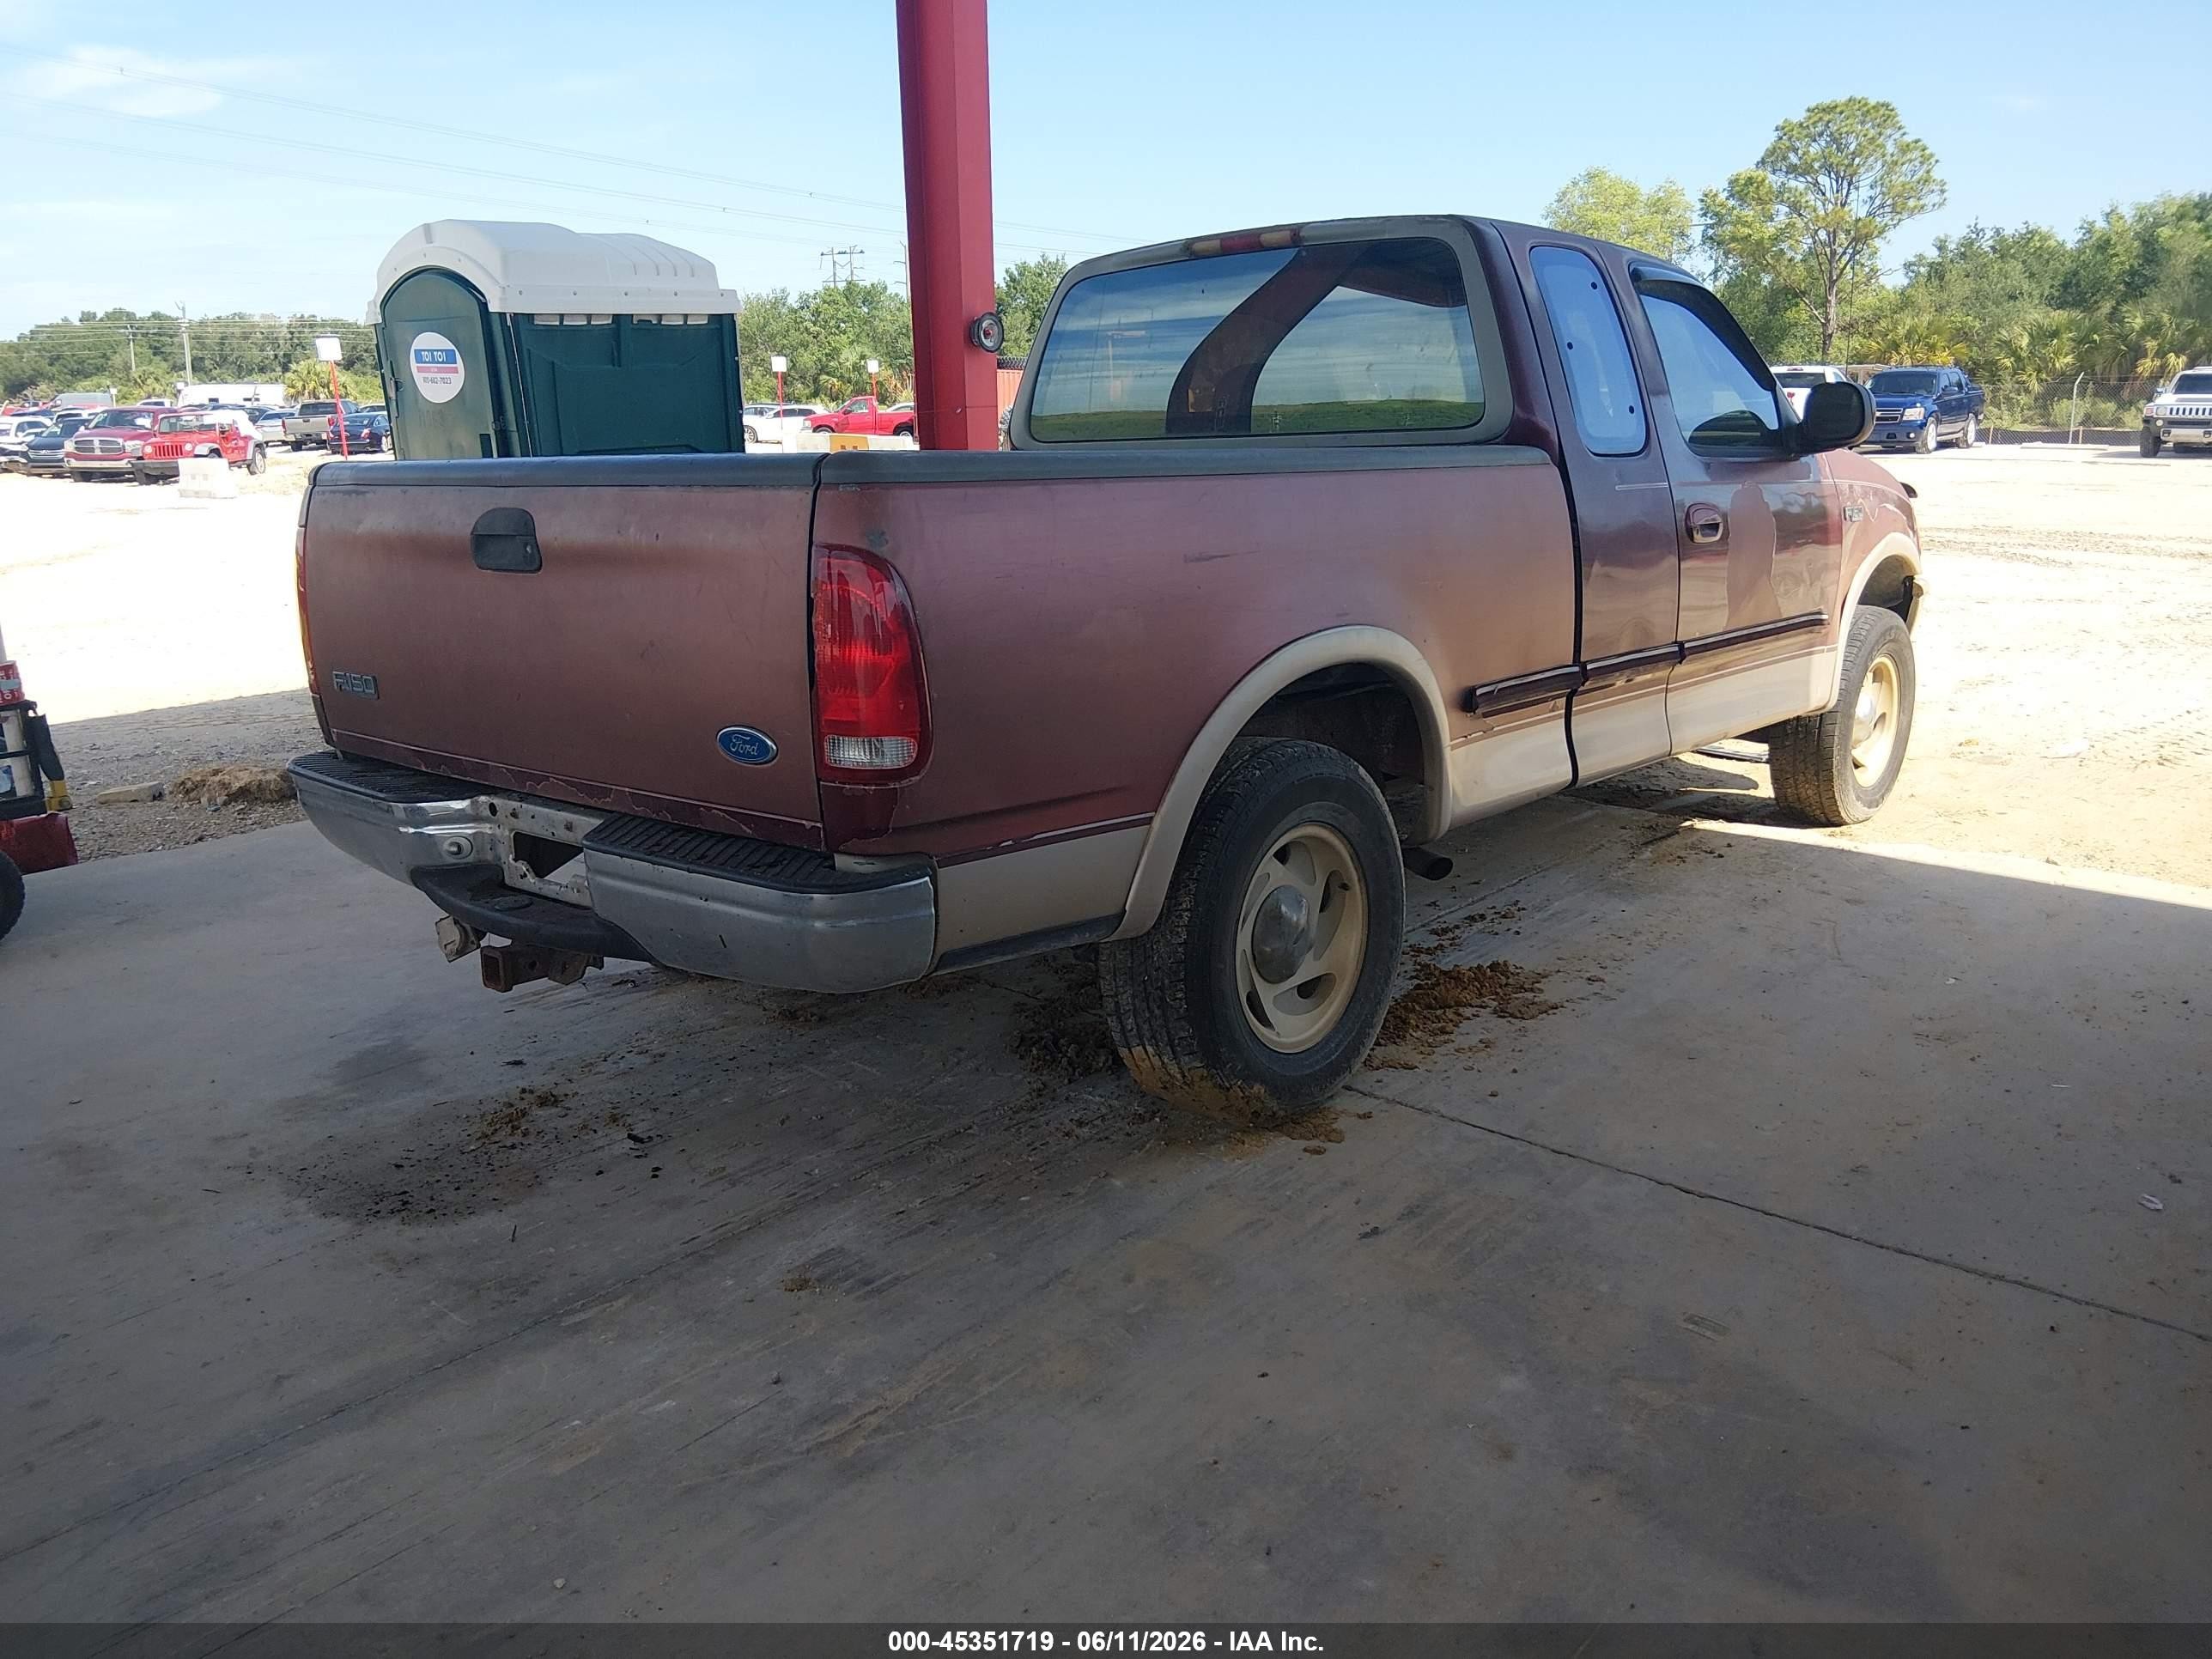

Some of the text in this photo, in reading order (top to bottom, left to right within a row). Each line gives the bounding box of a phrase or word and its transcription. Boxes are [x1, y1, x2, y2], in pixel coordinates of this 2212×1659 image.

[421, 351, 446, 362] TOI TOI
[729, 733, 759, 756] Ford
